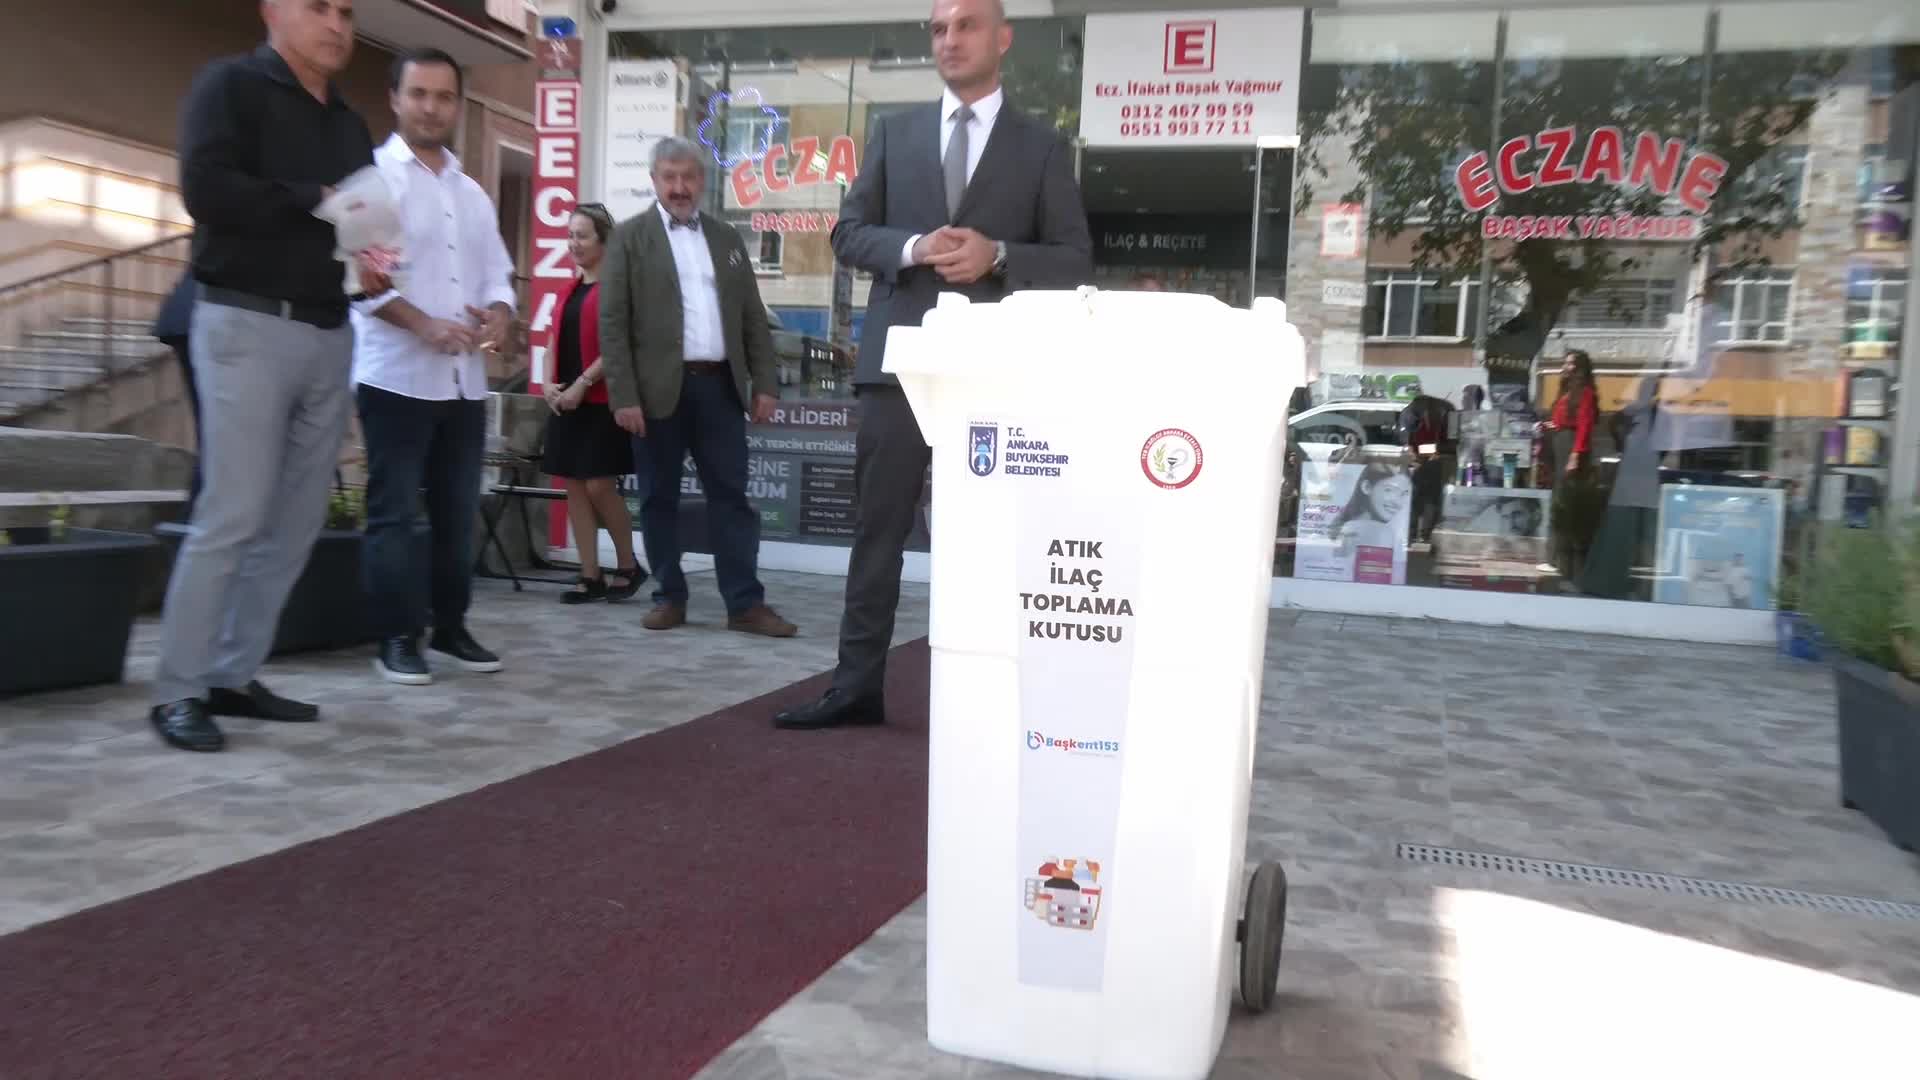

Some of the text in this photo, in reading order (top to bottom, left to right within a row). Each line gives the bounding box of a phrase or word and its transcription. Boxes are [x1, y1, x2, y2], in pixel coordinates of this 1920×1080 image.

[1174, 29, 1206, 66] E
[1127, 80, 1170, 97] İfakat
[1175, 80, 1220, 97] Başak
[1226, 80, 1283, 96] Yağmur
[545, 89, 576, 127] E
[1121, 102, 1254, 118] 0312 467 99 59
[1120, 120, 1252, 136] 0551 993 77 11
[1455, 126, 1729, 213] ECZANE
[1482, 212, 1700, 242] BAŞAK YAĞMUR
[1104, 231, 1207, 251] İLAÇ & REÇETE
[790, 406, 848, 426] LİDERİ
[1007, 427, 1025, 438] T.C.
[1006, 440, 1049, 451] ANKARA
[1047, 539, 1103, 559] ATIK
[1050, 562, 1103, 592] İLAÇ
[1019, 593, 1134, 616] TOPLAMA
[1029, 620, 1123, 643] KUTUSU
